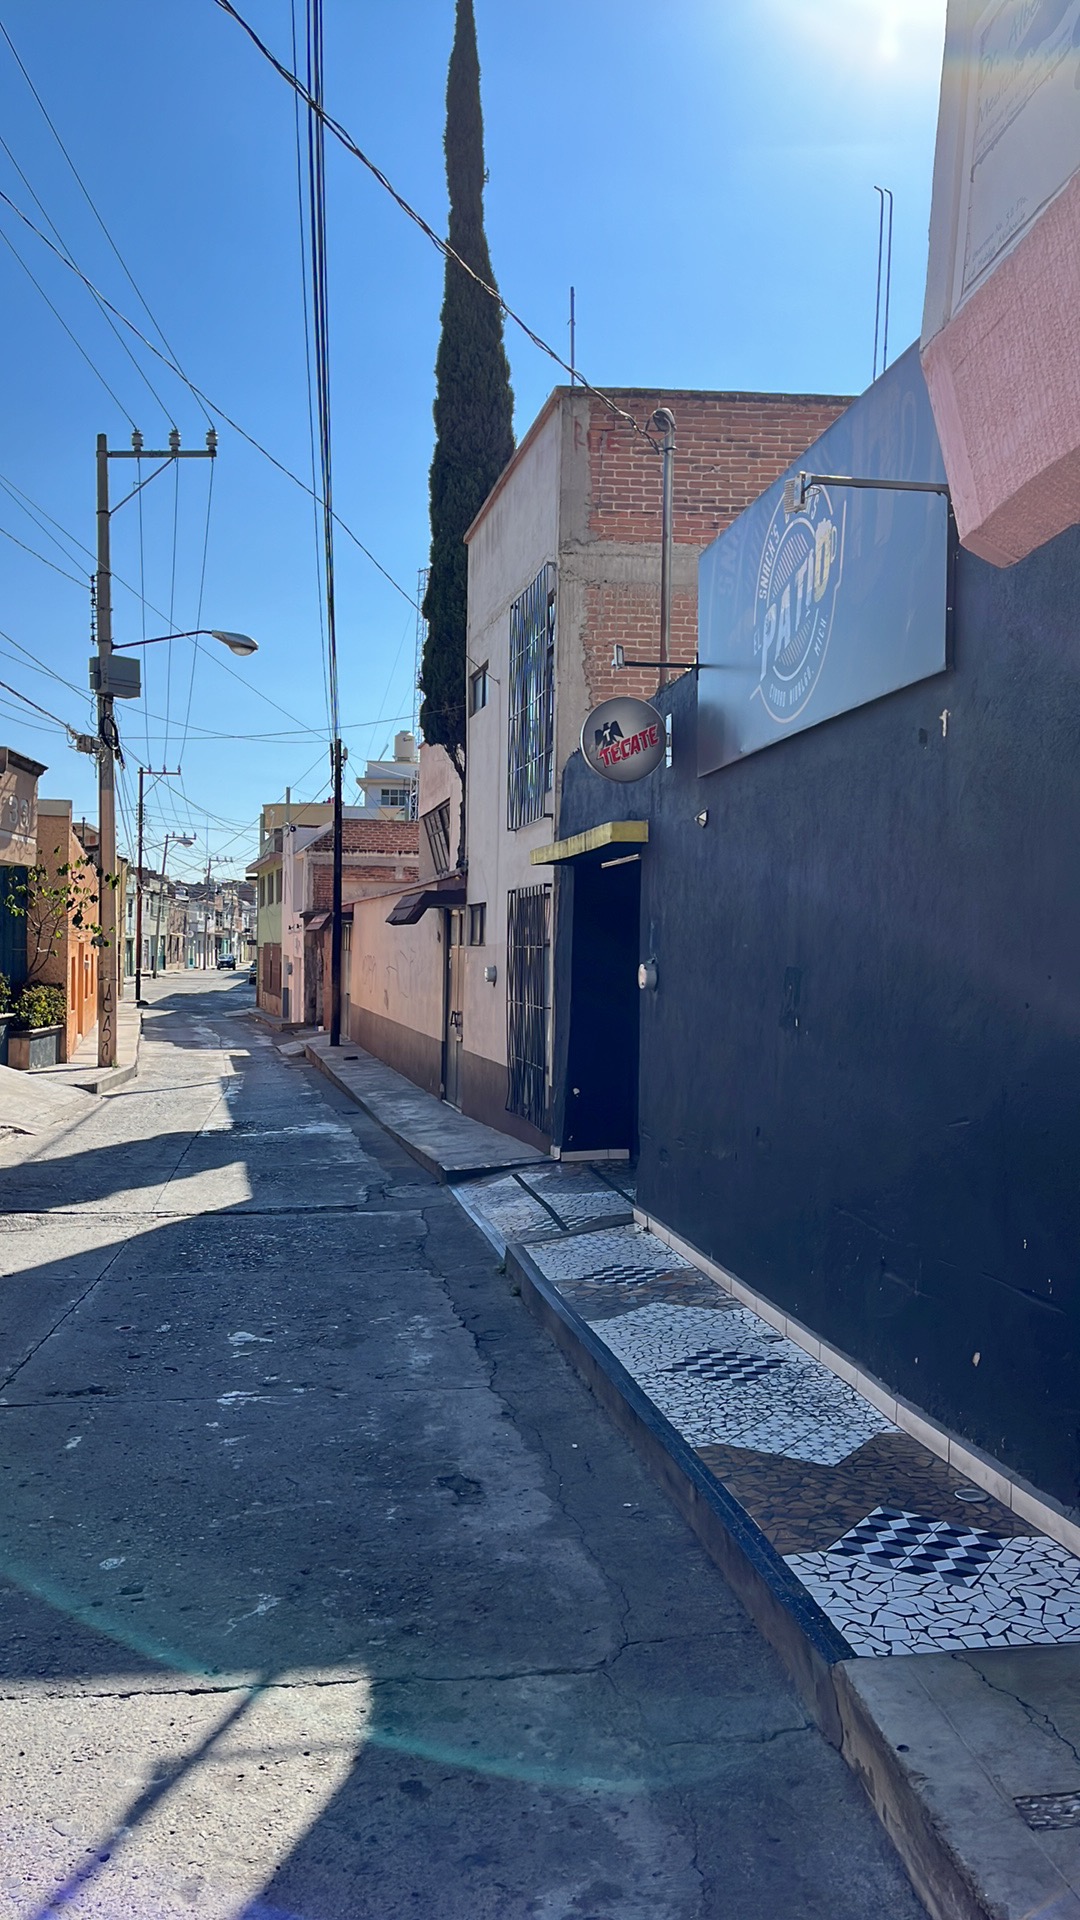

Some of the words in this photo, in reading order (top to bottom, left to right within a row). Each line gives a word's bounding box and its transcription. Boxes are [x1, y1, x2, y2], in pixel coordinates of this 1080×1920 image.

[753, 628, 762, 656] EL
[759, 517, 836, 682] PATIO
[597, 724, 659, 768] TECATE
